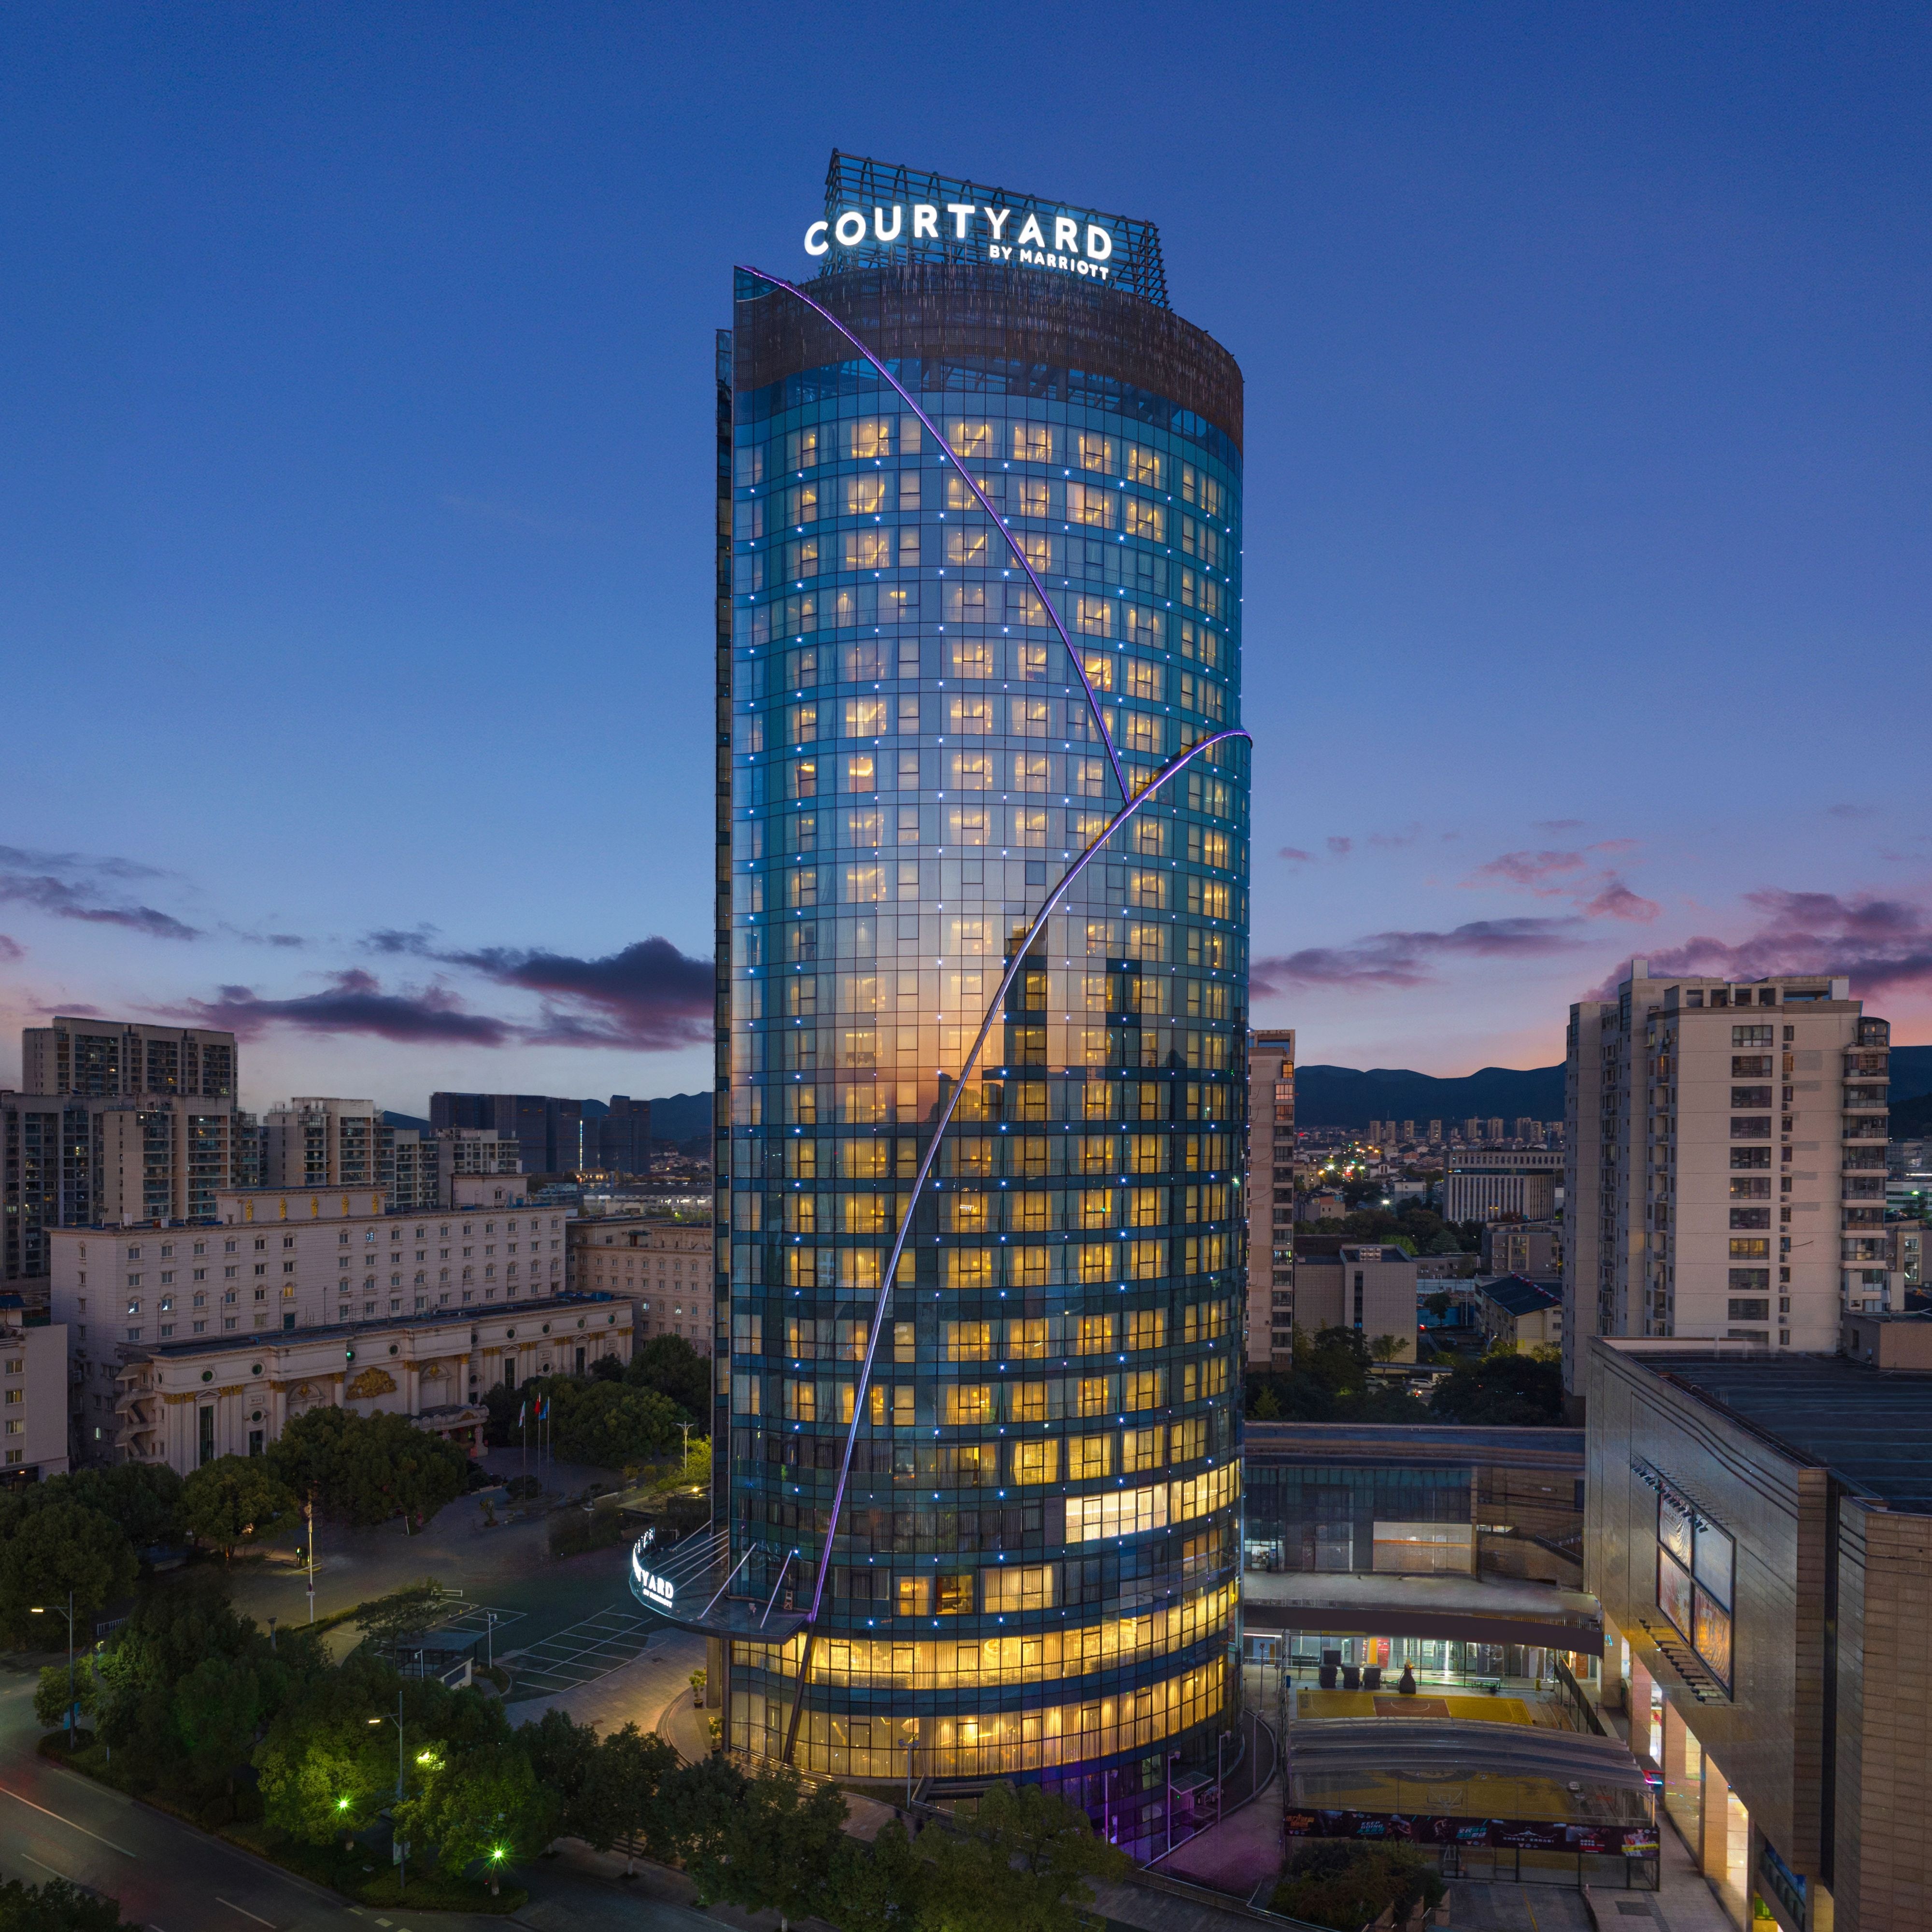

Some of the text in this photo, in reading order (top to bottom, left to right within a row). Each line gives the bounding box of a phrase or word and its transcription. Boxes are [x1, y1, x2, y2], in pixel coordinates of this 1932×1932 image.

[804, 203, 1112, 261] COURTYARD
[990, 244, 1109, 281] BY MARRIOTT
